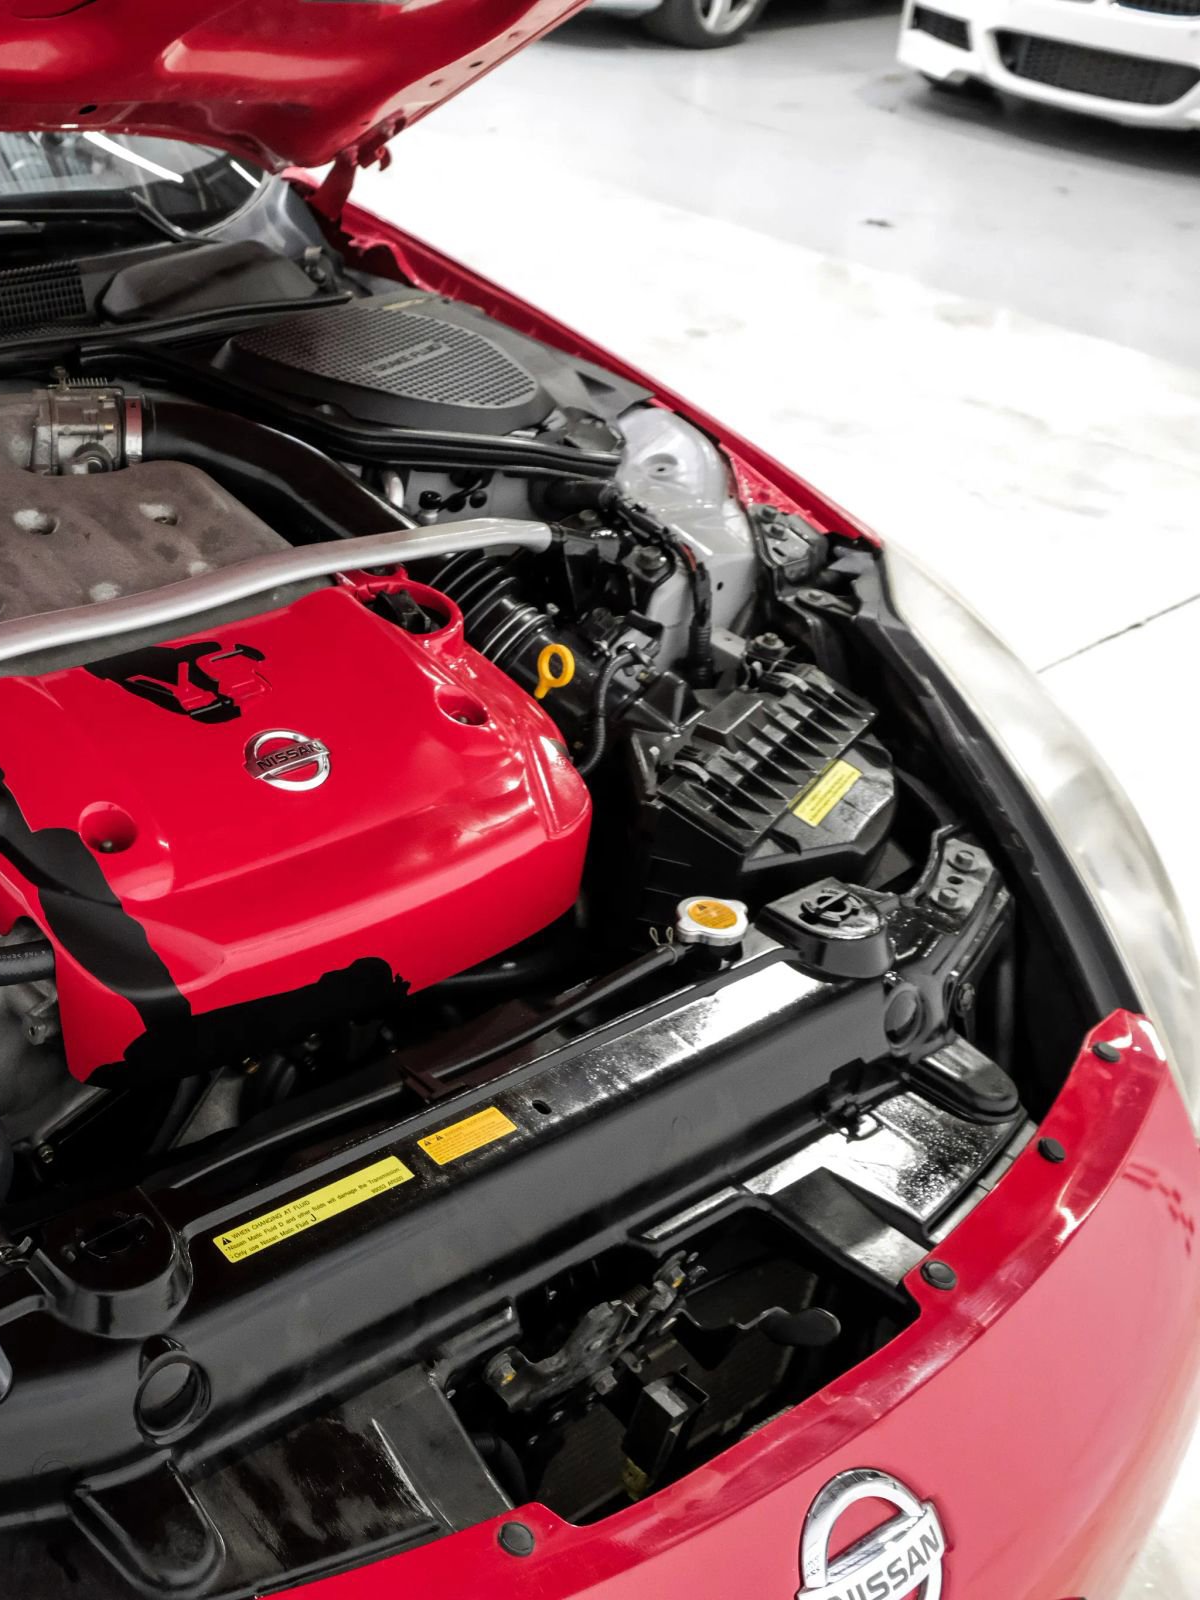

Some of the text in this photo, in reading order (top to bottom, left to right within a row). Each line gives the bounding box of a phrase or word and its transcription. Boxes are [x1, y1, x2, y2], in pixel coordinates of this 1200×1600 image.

[256, 742, 323, 770] NISSAN
[228, 1240, 246, 1250] Nissan
[248, 1231, 262, 1241] Matic
[264, 1225, 277, 1234] Fluid
[286, 1216, 296, 1224] and
[297, 1210, 310, 1218] other
[337, 1188, 357, 1199] damage
[231, 1228, 250, 1239] WHEN
[252, 1213, 282, 1229] CHANGING
[293, 1200, 310, 1210] FLUID
[234, 1250, 247, 1258] Only
[260, 1235, 278, 1245] Nissan
[280, 1227, 294, 1237] Matic
[295, 1220, 309, 1229] Fluid
